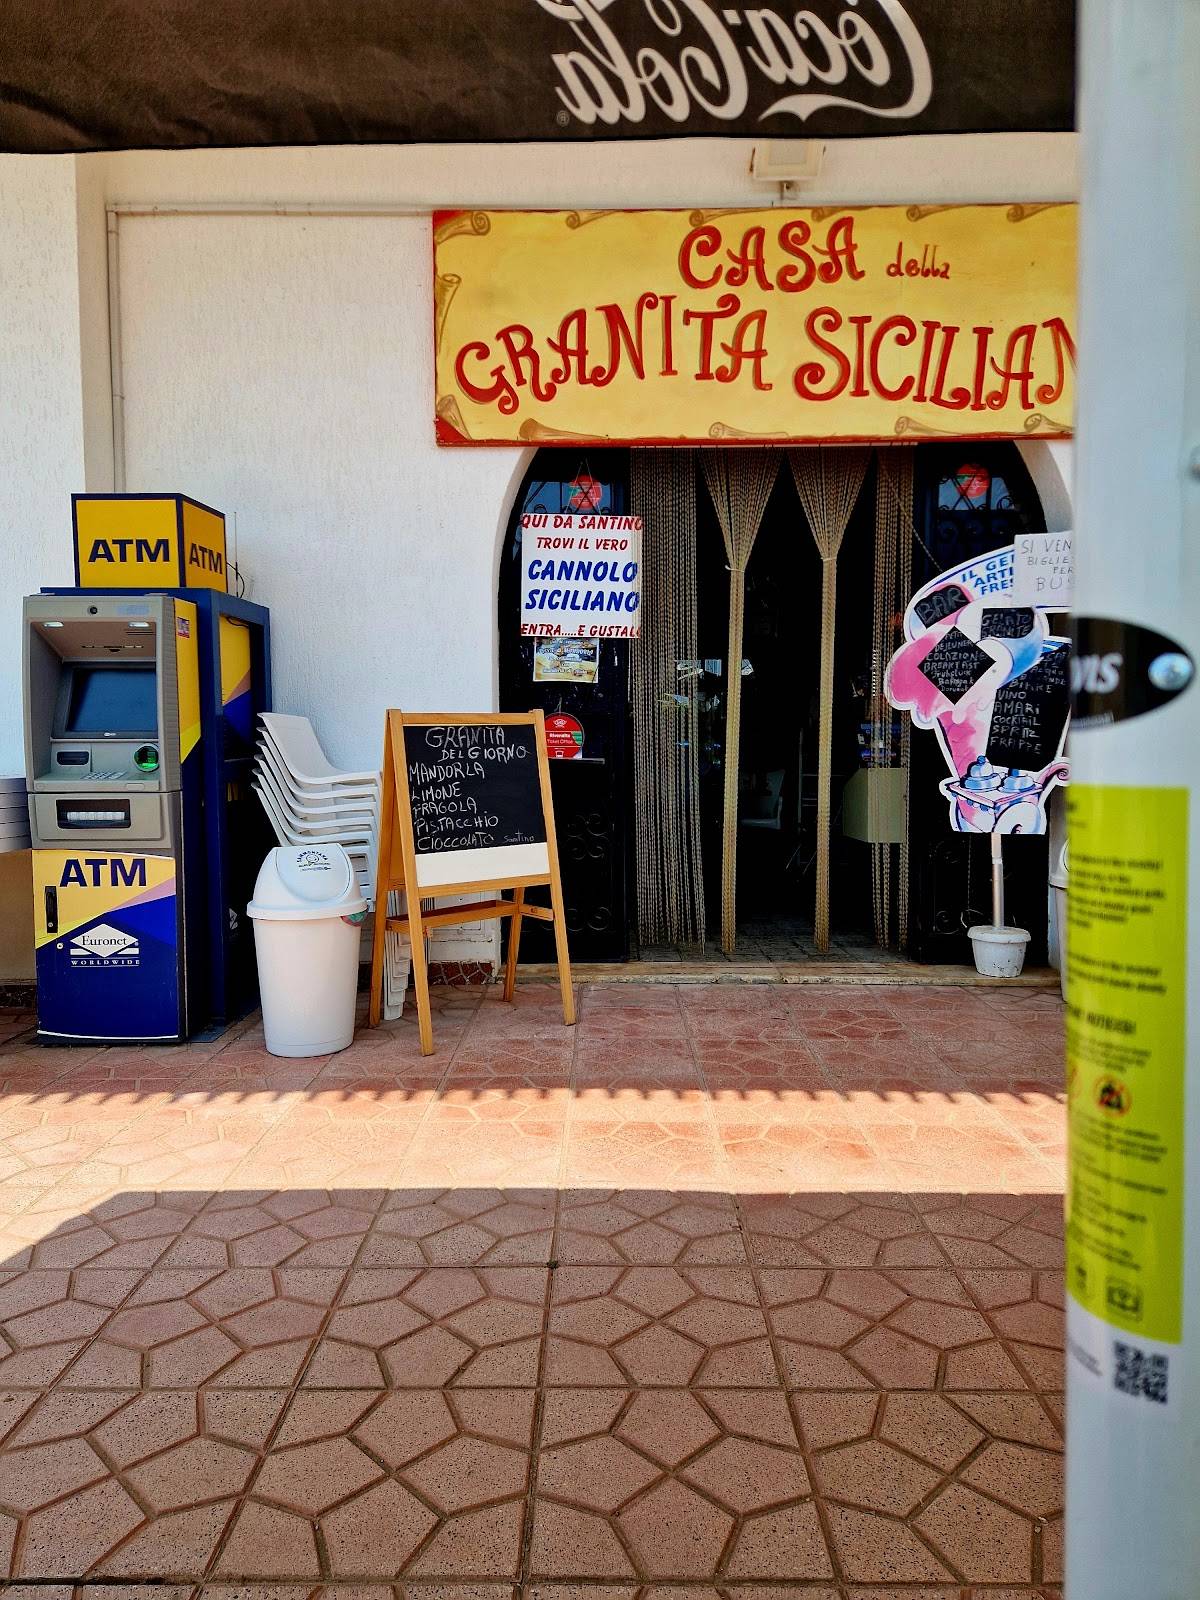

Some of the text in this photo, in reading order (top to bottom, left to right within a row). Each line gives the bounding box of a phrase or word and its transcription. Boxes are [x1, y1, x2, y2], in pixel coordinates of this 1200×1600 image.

[678, 215, 950, 293] CASA della
[454, 292, 1077, 416] GRANITA SICILIAN
[522, 514, 643, 530] QUI DA SANTINO
[88, 538, 170, 563] ATM
[537, 537, 628, 551] TROVI IL VERO
[189, 542, 223, 575] ATM
[528, 559, 638, 582] CANNOLO
[525, 588, 640, 612] SICILIANO
[917, 588, 967, 625] BAR
[997, 689, 1027, 701] VINO
[425, 726, 505, 748] GRANITA
[438, 744, 530, 764] DEL GIORNO
[409, 761, 485, 785] MANDORLA
[411, 782, 462, 802] LIMONE
[413, 797, 477, 819] FRAGOLA
[417, 831, 495, 850] CIOCCOLATO
[59, 858, 147, 887] ATM
[82, 935, 127, 946] Euronet
